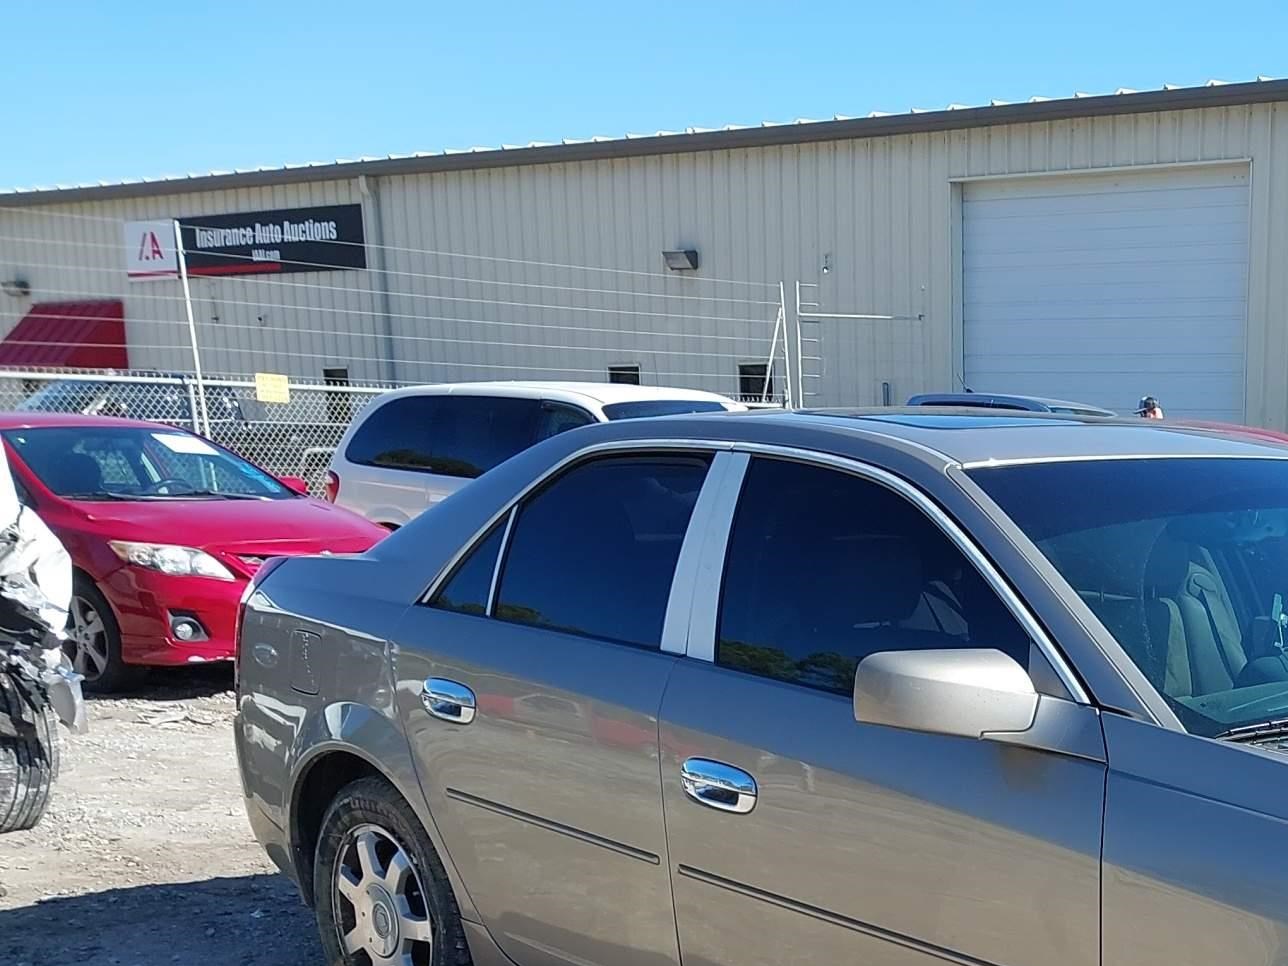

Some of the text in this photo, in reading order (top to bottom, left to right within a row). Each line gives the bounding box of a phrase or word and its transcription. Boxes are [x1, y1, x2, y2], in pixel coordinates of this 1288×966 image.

[195, 219, 338, 249] Insurance Auto Auctions
